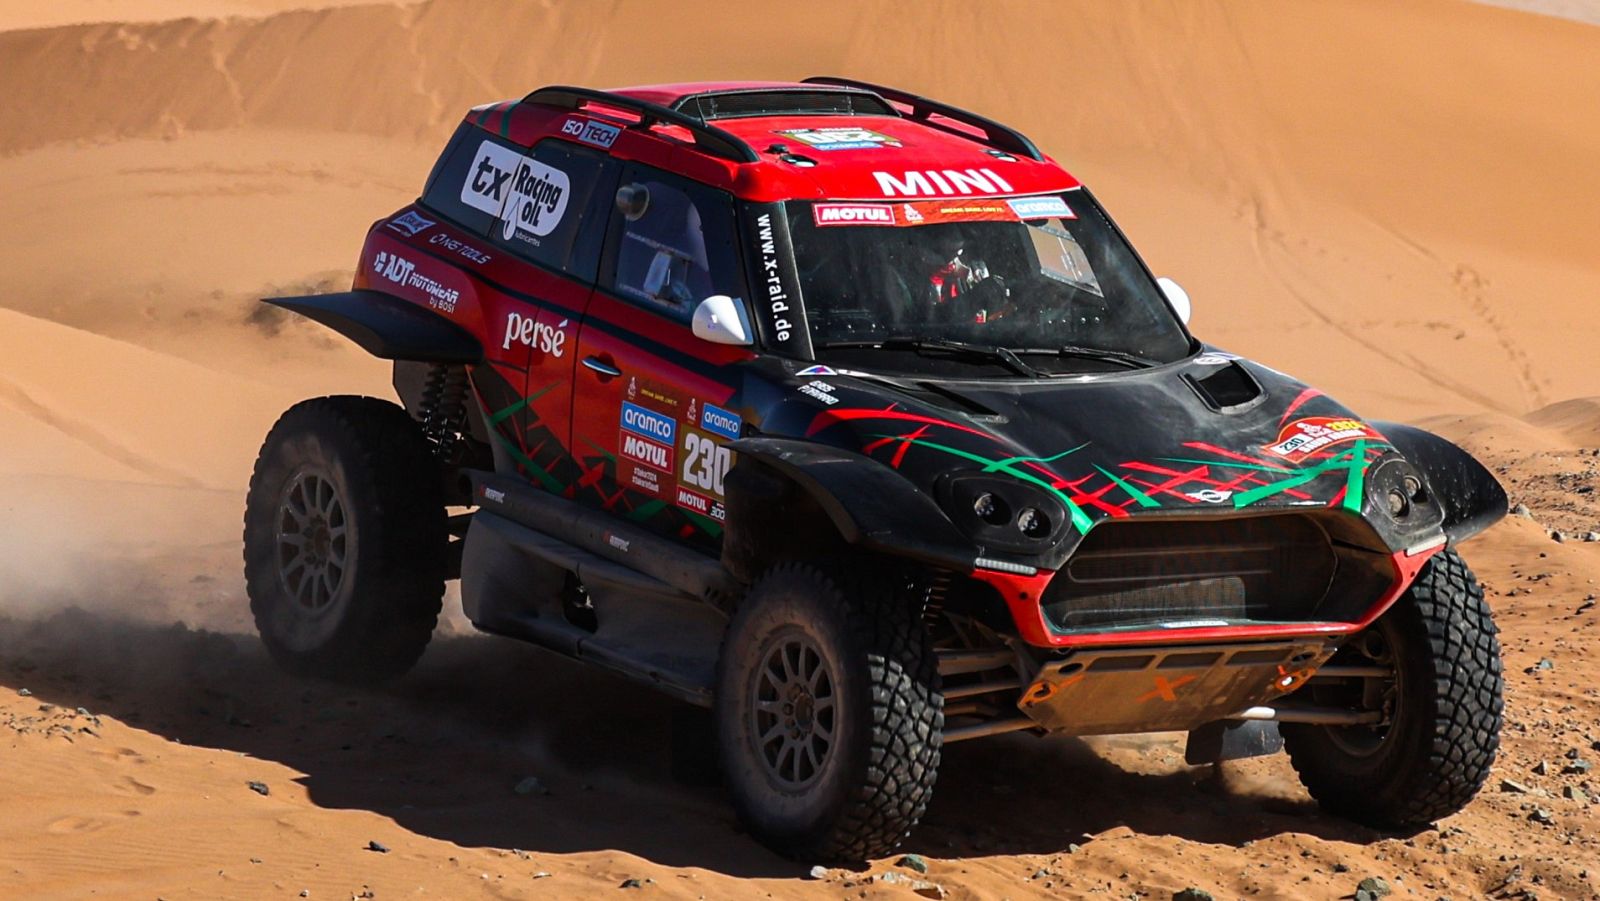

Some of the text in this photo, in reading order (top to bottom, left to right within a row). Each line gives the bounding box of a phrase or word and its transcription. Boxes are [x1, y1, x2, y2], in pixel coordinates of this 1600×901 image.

[561, 119, 617, 145] ISO TECH
[471, 155, 513, 202] tx
[514, 163, 563, 214] Racing
[872, 168, 1014, 196] MINI
[821, 207, 890, 221] MOTUL
[1015, 202, 1066, 213] aramco
[382, 254, 415, 287] ADT
[757, 213, 793, 343] www.x-raid.de
[502, 312, 568, 358] persé
[624, 408, 671, 438] aramco
[704, 410, 739, 434] aramco
[623, 436, 668, 468] MOTUL
[1279, 437, 1305, 452] 230
[682, 432, 731, 497] 230
[678, 491, 707, 511] MOTUL
